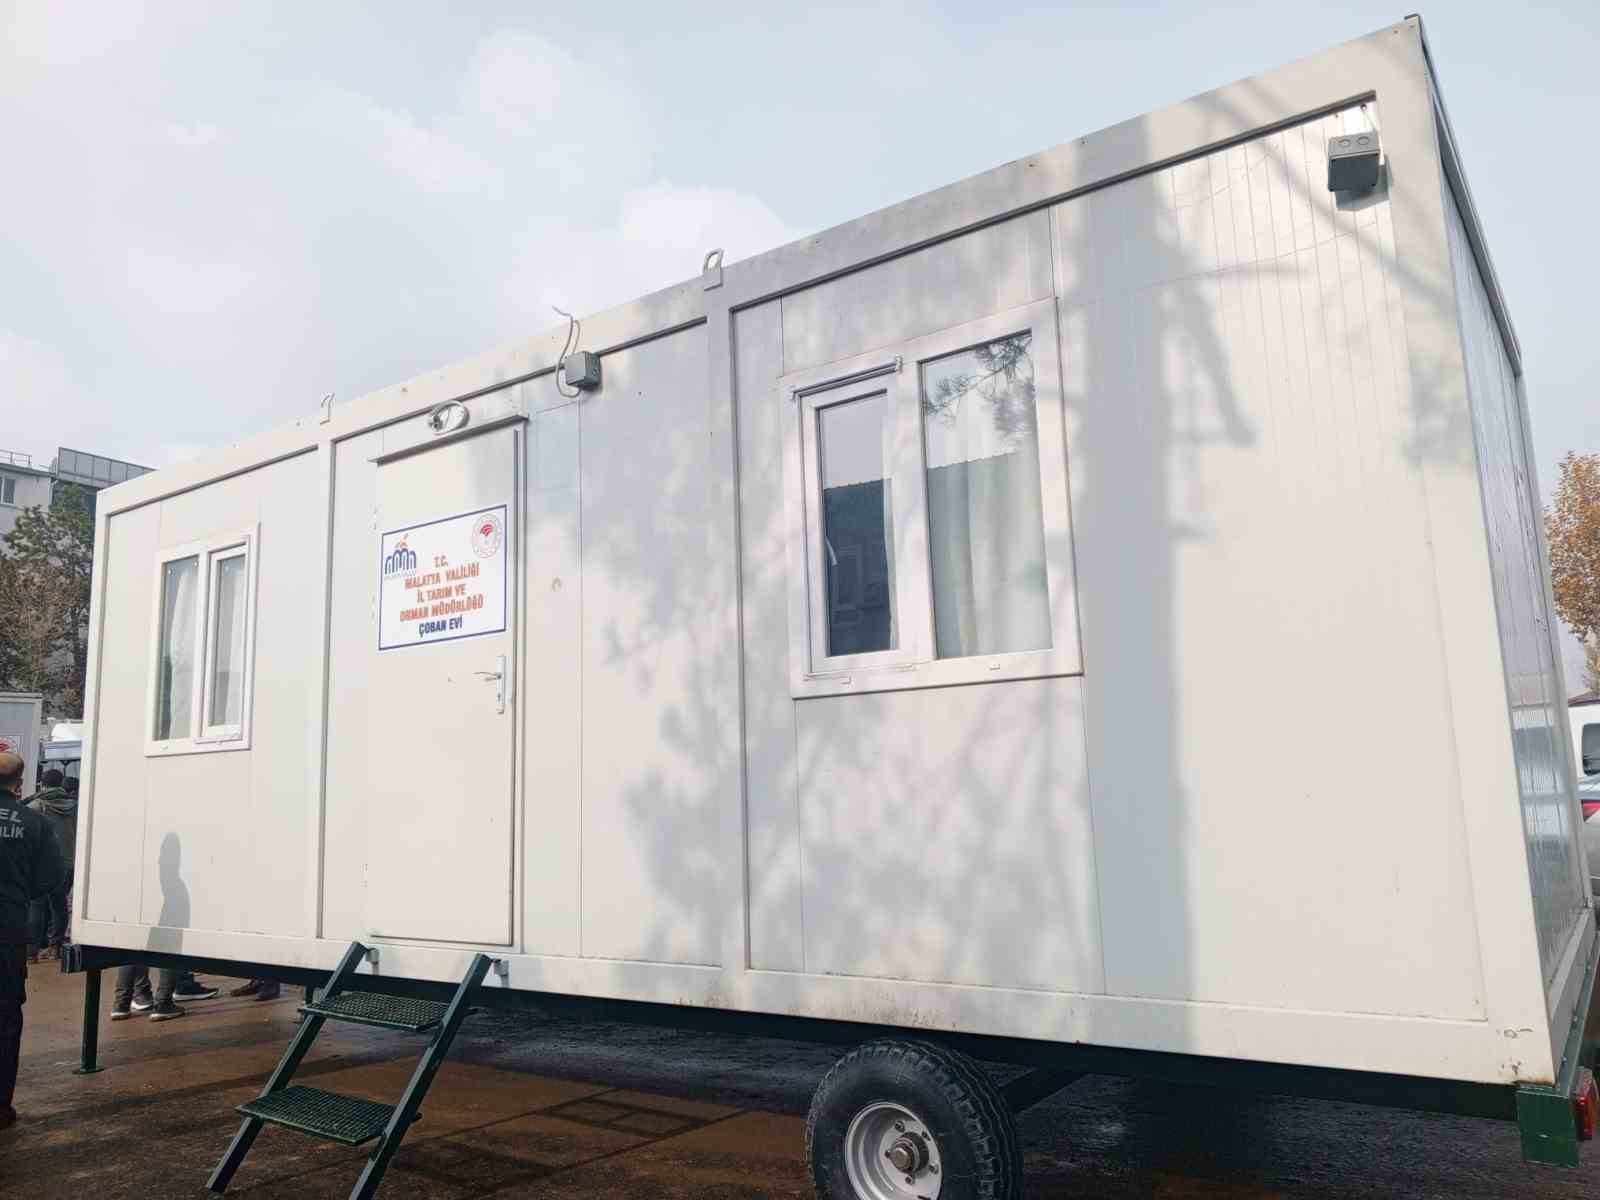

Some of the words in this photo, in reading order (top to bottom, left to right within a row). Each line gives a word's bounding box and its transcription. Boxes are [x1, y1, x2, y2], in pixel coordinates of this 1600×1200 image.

[404, 573, 440, 589] MALATYA
[428, 585, 451, 601] TARIM
[454, 583, 466, 595] VE
[400, 607, 428, 622] ORMAN
[419, 619, 447, 637] ÇOBAN
[449, 614, 462, 630] EVİ
